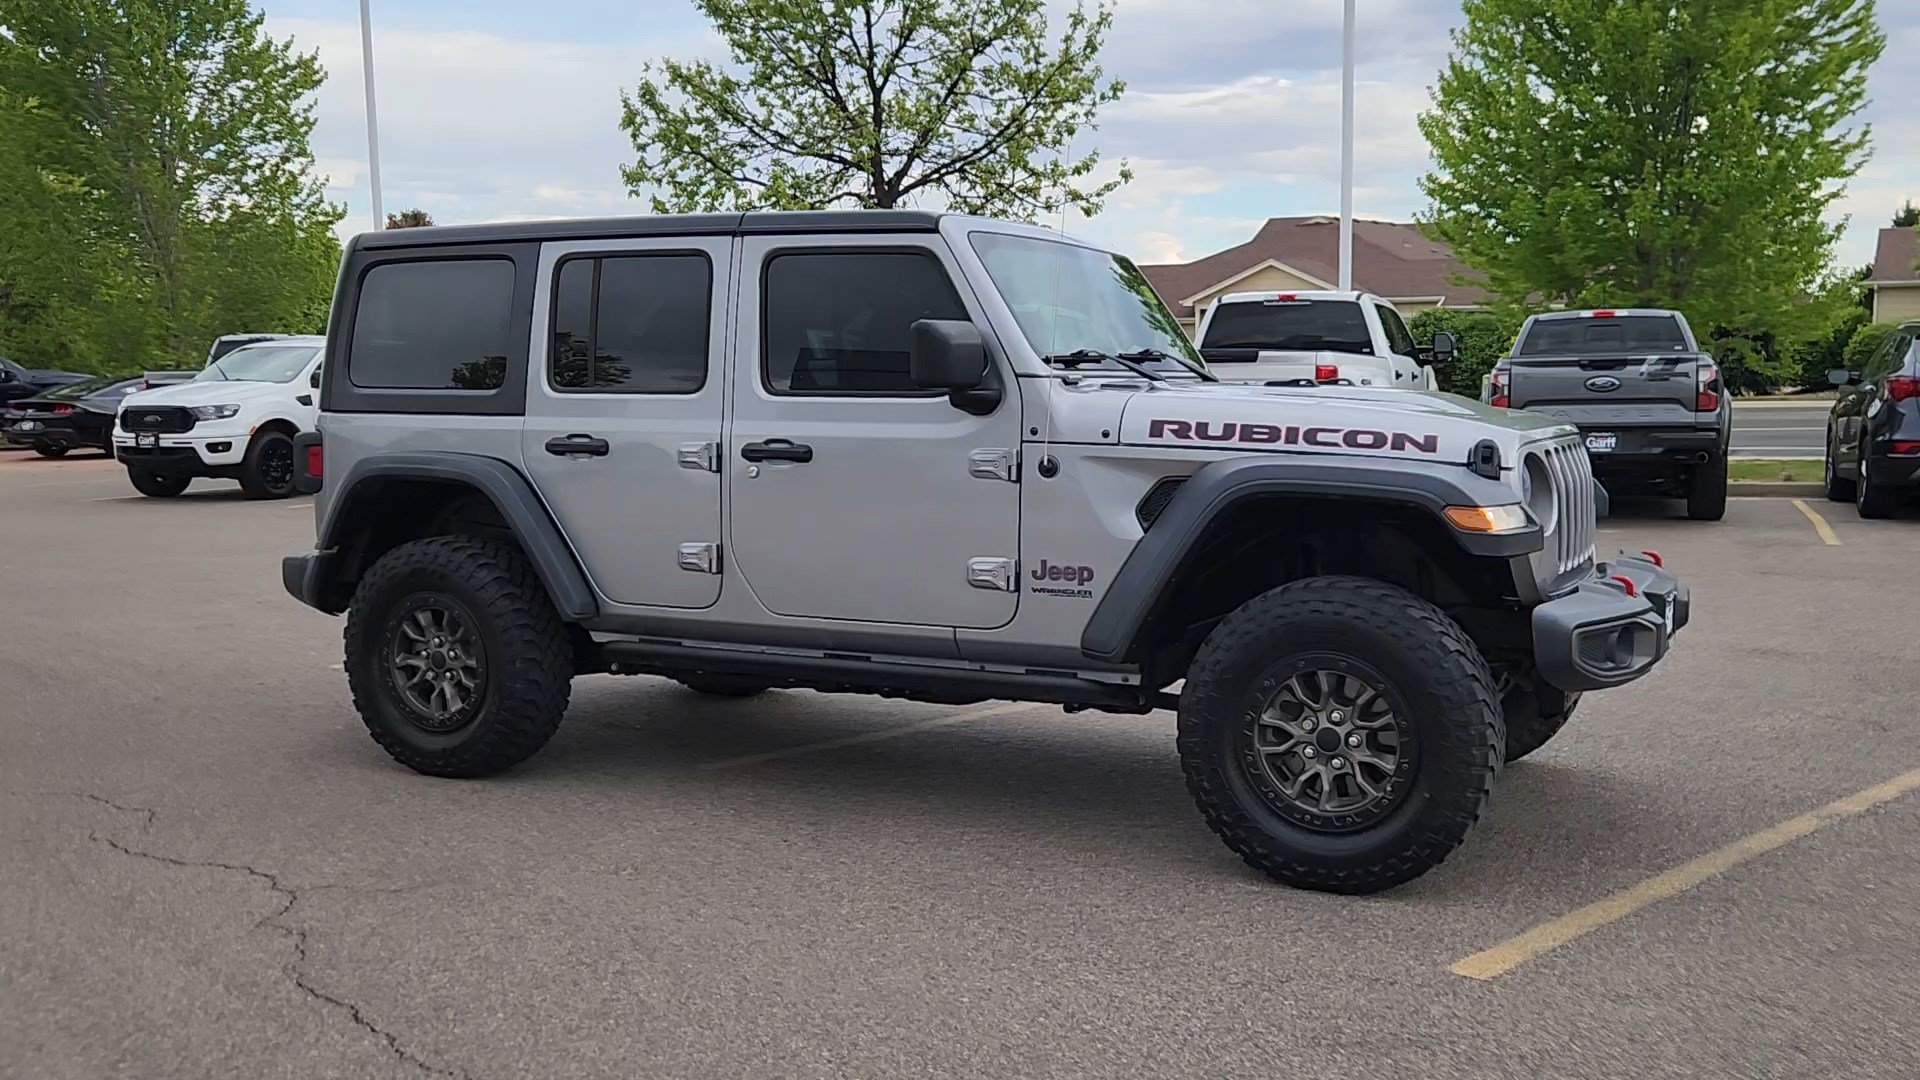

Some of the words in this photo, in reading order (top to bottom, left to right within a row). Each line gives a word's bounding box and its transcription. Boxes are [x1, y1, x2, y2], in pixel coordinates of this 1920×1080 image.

[1148, 419, 1439, 453] RUBICON
[1585, 436, 1617, 448] Garff
[1031, 559, 1094, 586] Jeep
